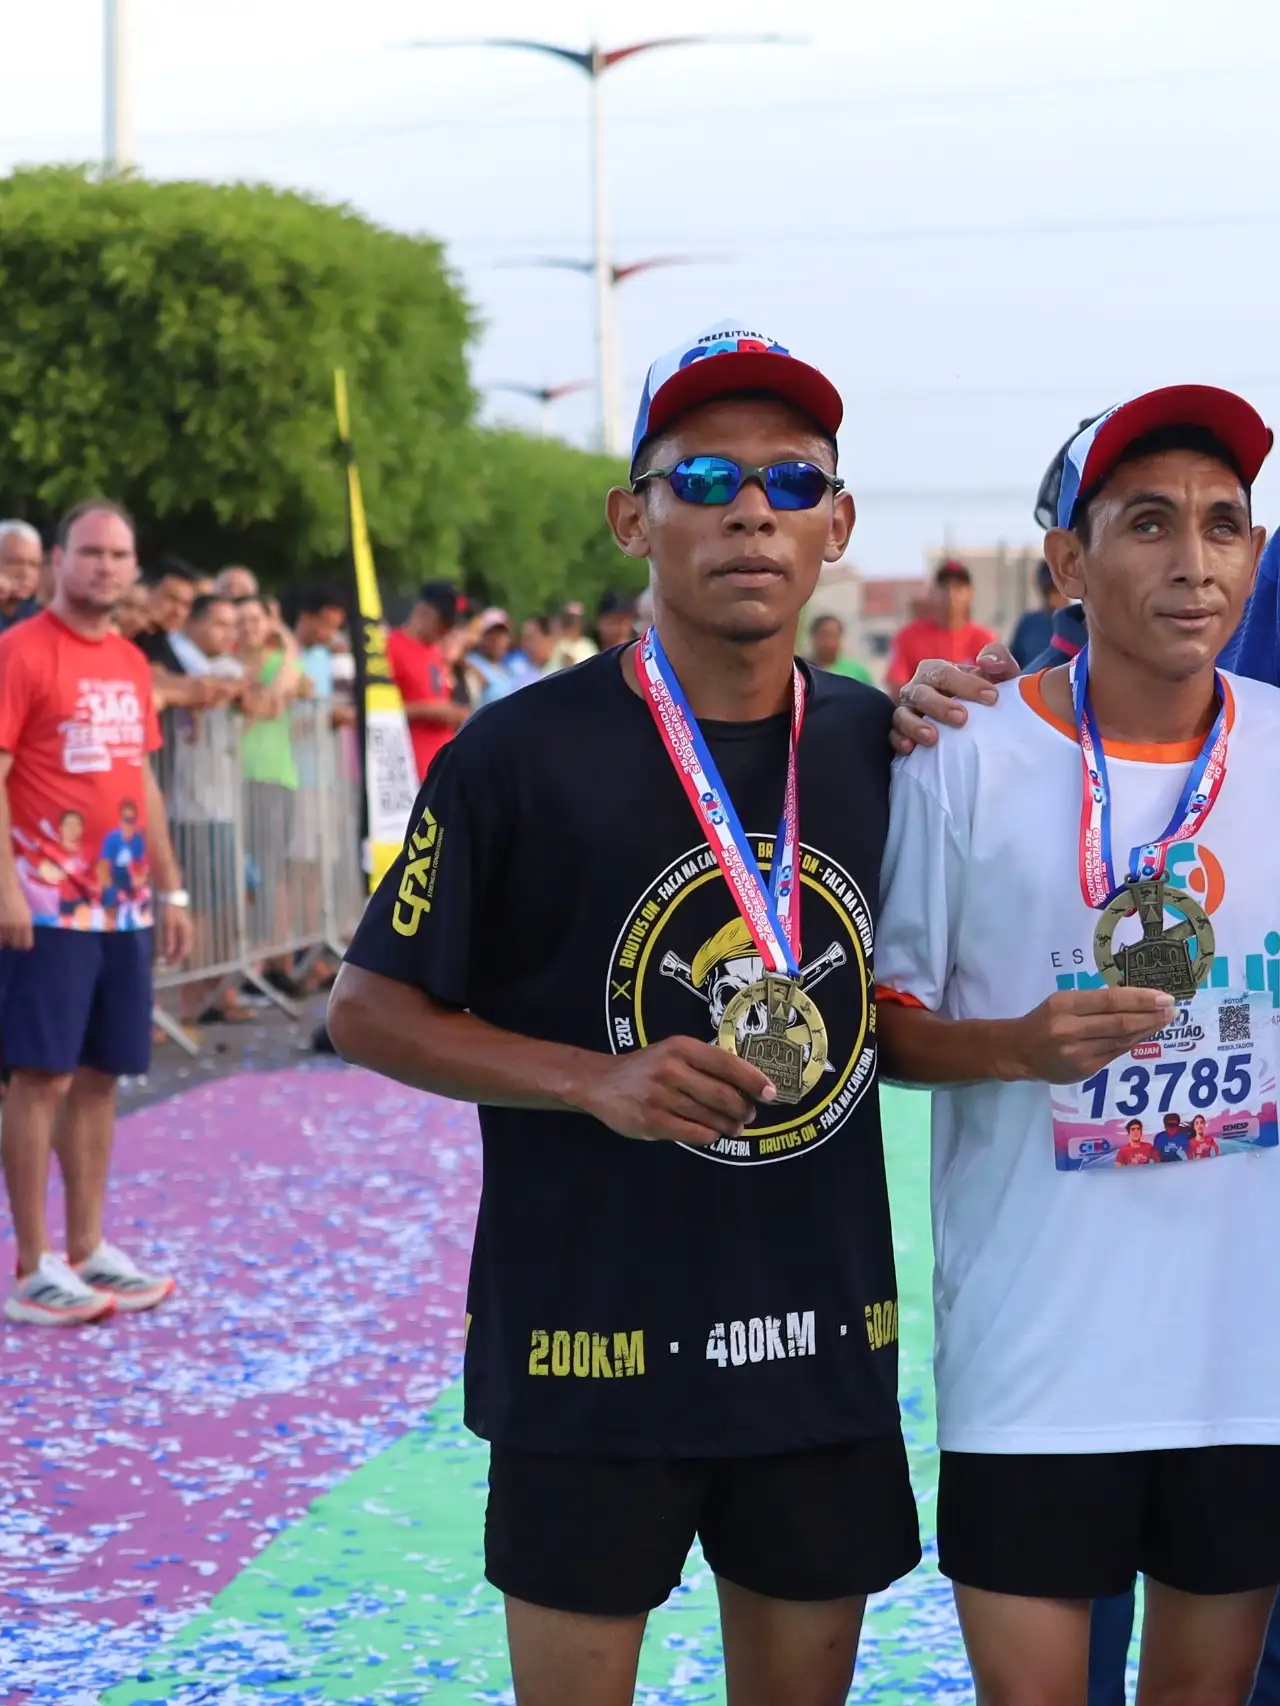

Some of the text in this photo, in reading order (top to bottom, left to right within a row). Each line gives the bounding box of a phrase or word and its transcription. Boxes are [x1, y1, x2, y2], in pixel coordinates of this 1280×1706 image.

[698, 330, 764, 345] PREFEITURA
[647, 683, 661, 702] DE
[652, 678, 689, 746] SEBASTIÃO
[655, 703, 685, 756] CORRIDA
[427, 870, 437, 898] STRENGTH
[720, 848, 733, 867] DE
[726, 843, 764, 914] SEBASTIÃO
[1084, 828, 1095, 898] CORRIDA DE
[1091, 827, 1103, 894] SEBASTIÃO
[619, 917, 650, 968] BRUTUS
[640, 899, 661, 921] ON
[680, 859, 700, 879] NA
[728, 868, 758, 922] CORRIDA
[802, 854, 875, 958] ON FACA NA CAVEIRA
[614, 1016, 634, 1048] 2022
[869, 1003, 877, 1034] 2022
[1132, 1046, 1160, 1056] 20JAN
[1217, 1042, 1254, 1052] RESULTADOS
[710, 1138, 750, 1156] CAVEIRA
[759, 1132, 802, 1155] BRUTUS
[801, 1123, 817, 1140] ON
[838, 1092, 851, 1110] NA
[849, 1047, 875, 1093] CAVEIRA
[1081, 1053, 1252, 1119] 13785
[1222, 1122, 1249, 1132] SEMESP
[528, 1329, 645, 1378] 200KM
[706, 1310, 816, 1368] 400KM
